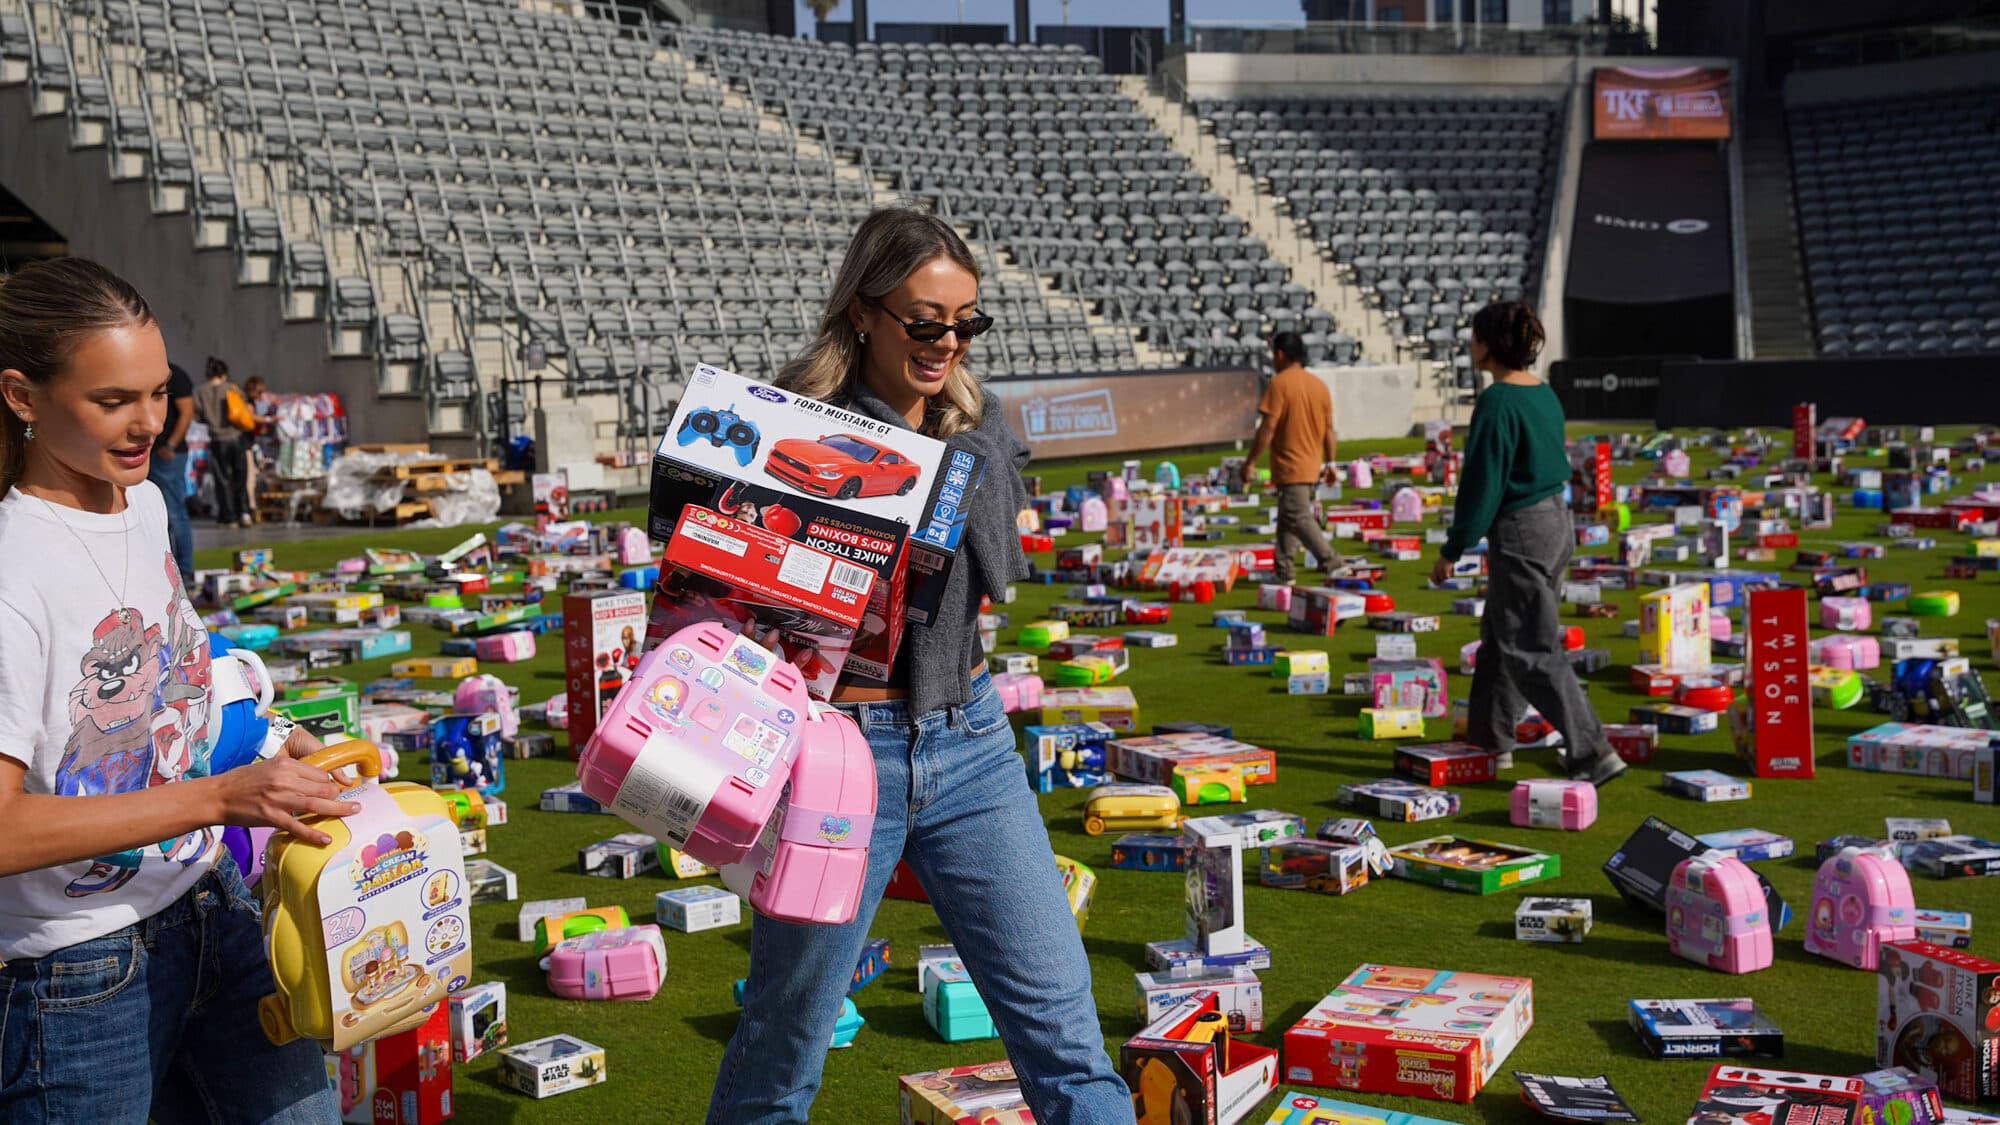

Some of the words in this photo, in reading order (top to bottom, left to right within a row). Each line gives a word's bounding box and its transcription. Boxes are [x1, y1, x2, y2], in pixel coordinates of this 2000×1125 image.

[794, 398, 823, 411] FORD
[824, 406, 875, 430] MUSTANG
[877, 424, 893, 436] GT
[816, 515, 830, 524] SET
[831, 518, 862, 533] GLOVES
[810, 525, 858, 544] BOXING
[864, 527, 896, 541] BOXING
[806, 536, 850, 557] TYSON
[862, 538, 893, 553] KID'S
[853, 549, 888, 565] MIKE
[596, 600, 615, 609] MIKE
[616, 597, 642, 607] TYSON
[831, 593, 856, 605] WORLD
[569, 620, 582, 715] TYSON
[1762, 616, 1782, 724] TYSON
[1782, 634, 1799, 704] MIKE
[779, 711, 794, 723] 3+
[752, 769, 764, 779] 19
[365, 866, 379, 878] ICE
[382, 851, 415, 868] CREAM
[361, 859, 423, 893] PARLOR
[329, 909, 355, 935] 27
[448, 979, 465, 991] 3+
[1965, 975, 1974, 1010] MIKE
[1150, 992, 1170, 1004] FORD
[1956, 974, 1965, 1017] TYSON
[1664, 1043, 1720, 1054] HORNET
[1982, 1039, 1990, 1071] TYSON
[545, 1063, 570, 1075] STAR
[1399, 1068, 1454, 1083] MARKET
[542, 1071, 569, 1083] WARS
[382, 1100, 394, 1120] 33
